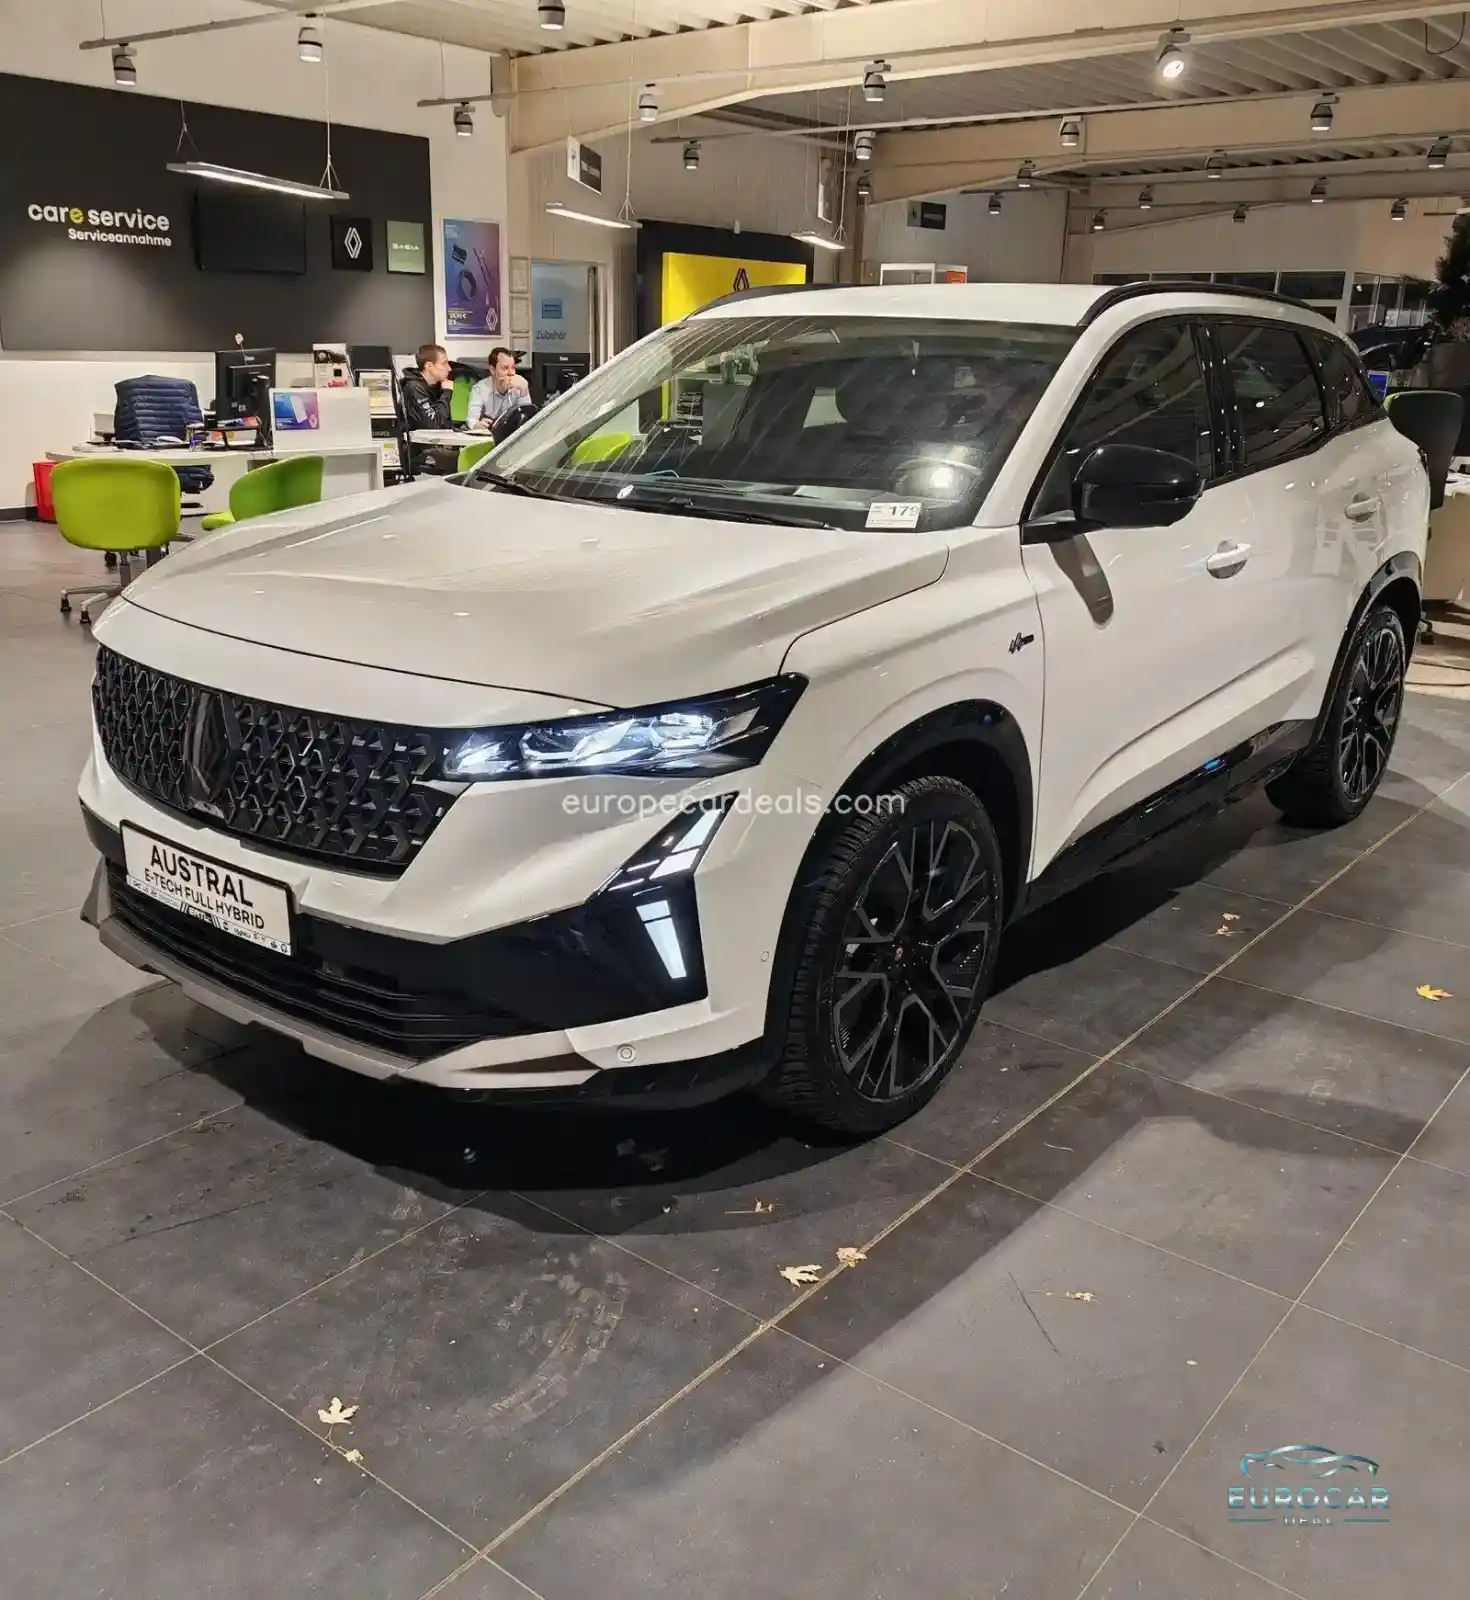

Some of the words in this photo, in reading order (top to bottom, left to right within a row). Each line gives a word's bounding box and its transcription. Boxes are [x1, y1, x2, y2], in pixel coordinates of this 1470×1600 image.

[28, 203, 84, 224] care
[88, 209, 170, 231] service
[68, 228, 172, 247] Serviceannahme
[144, 868, 183, 897] E-TECH
[185, 887, 214, 911] FULL
[215, 899, 265, 930] HYBRID
[151, 845, 253, 908] AUSTRAL
